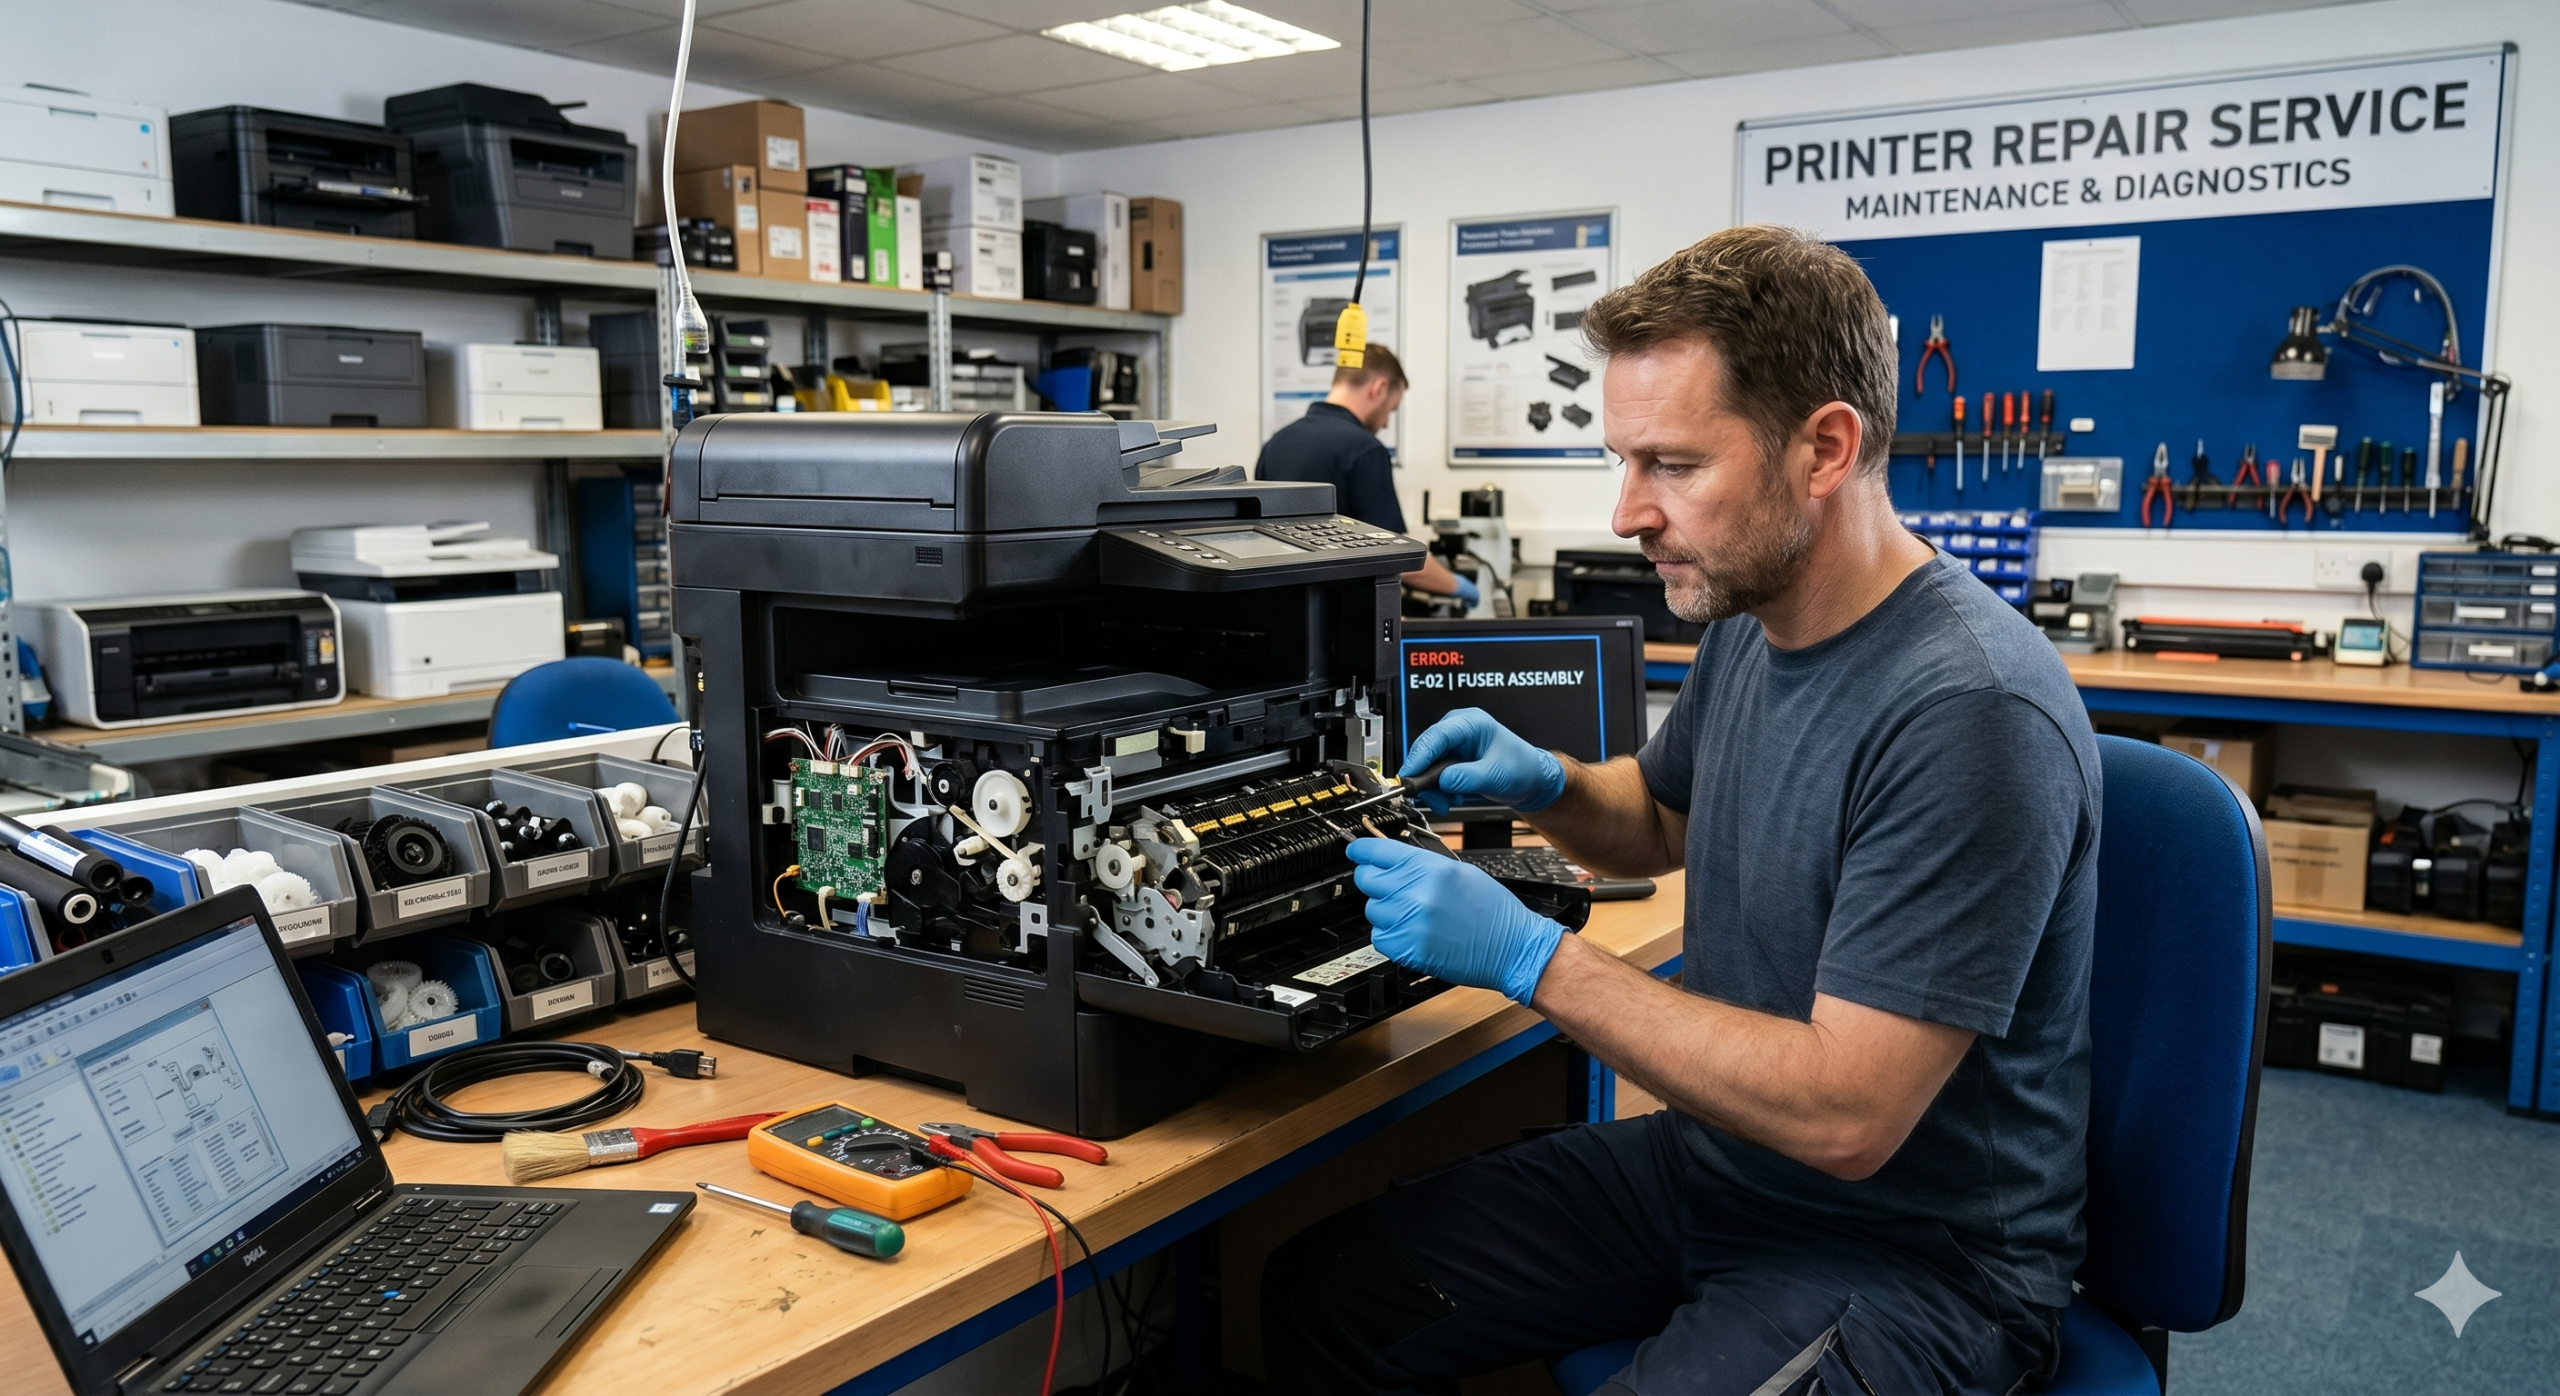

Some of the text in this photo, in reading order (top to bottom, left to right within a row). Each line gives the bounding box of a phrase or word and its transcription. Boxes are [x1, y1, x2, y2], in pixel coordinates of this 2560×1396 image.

[1764, 80, 2470, 186] PRINTER REPAIR SERVICE
[1845, 158, 2352, 221] MAINTENANCE & DIAGNOSTICS
[1409, 651, 1465, 667] ERROR:
[1409, 673, 1445, 689] E-02
[1457, 672, 1505, 688] FUSER
[1507, 670, 1584, 687] ASSEMBLY
[242, 1245, 267, 1267] DELL
